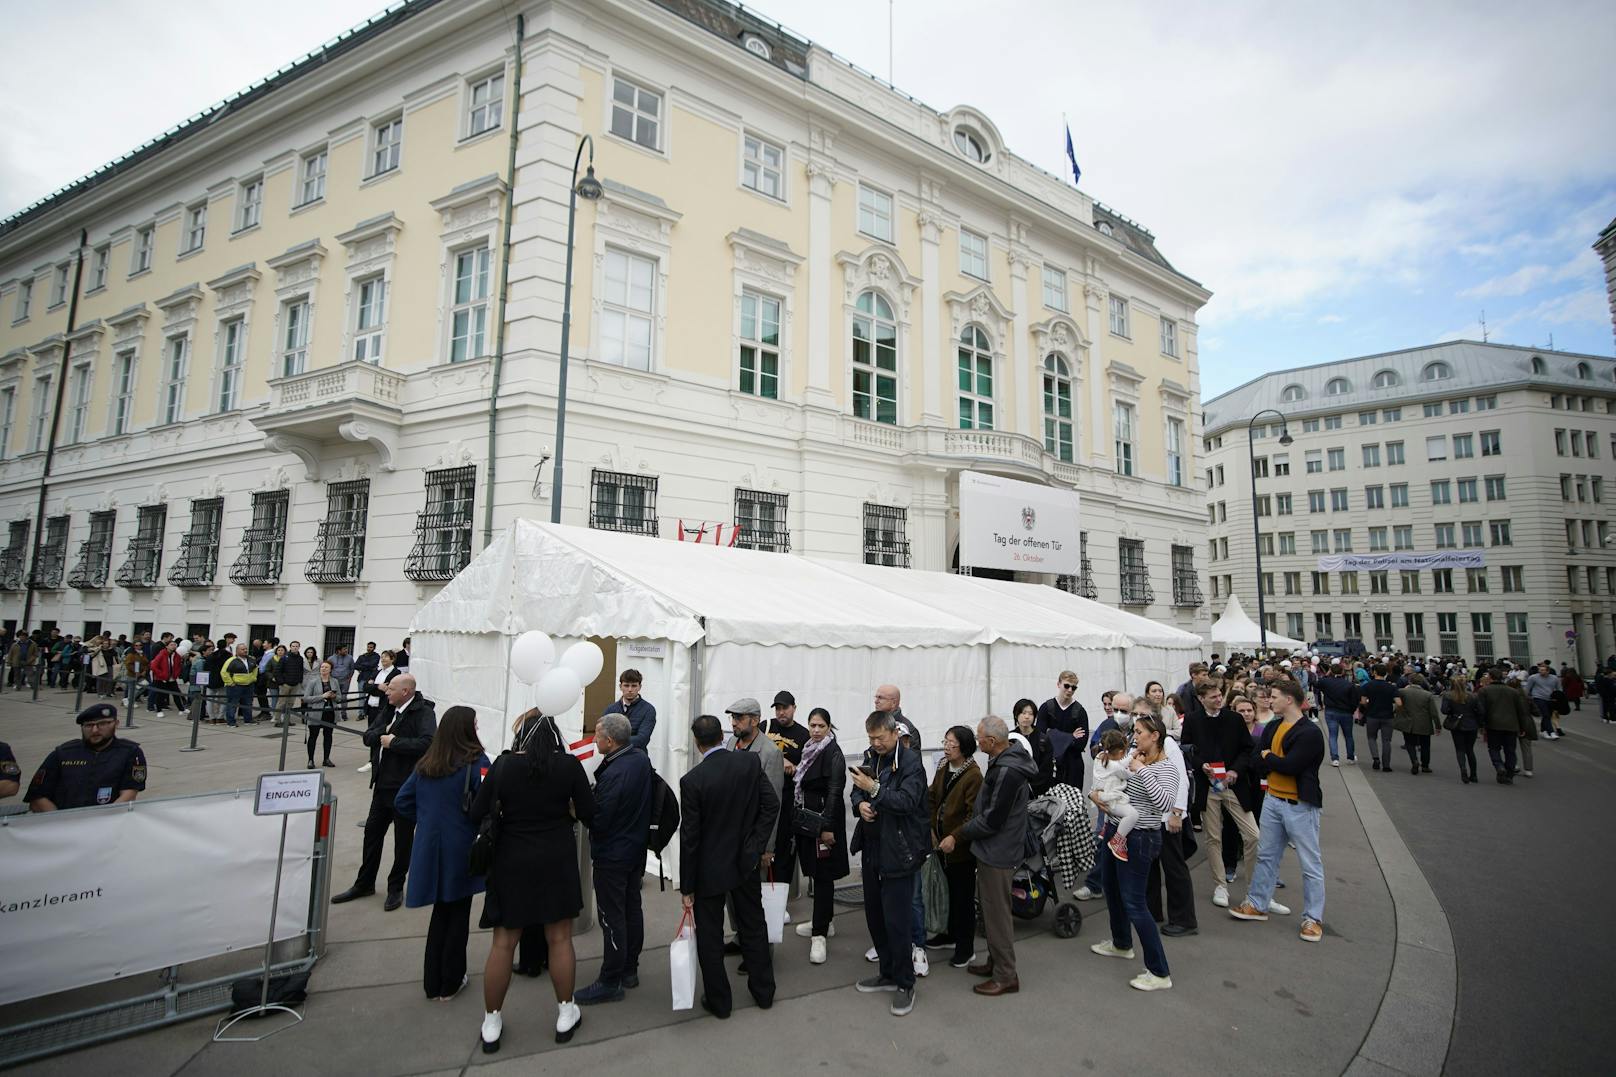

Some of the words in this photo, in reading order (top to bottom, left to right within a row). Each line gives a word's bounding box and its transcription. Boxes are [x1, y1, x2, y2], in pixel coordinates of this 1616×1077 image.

[993, 532, 1007, 547] Tag
[1008, 534, 1021, 546] der
[1022, 536, 1050, 550] offenen
[1051, 540, 1063, 551] Tür
[1023, 553, 1044, 563] Oktober
[1343, 559, 1357, 567] Tag
[1373, 557, 1398, 565] Polizei
[1414, 555, 1481, 564] Nationalfeiertag
[265, 789, 311, 800] EINGANG
